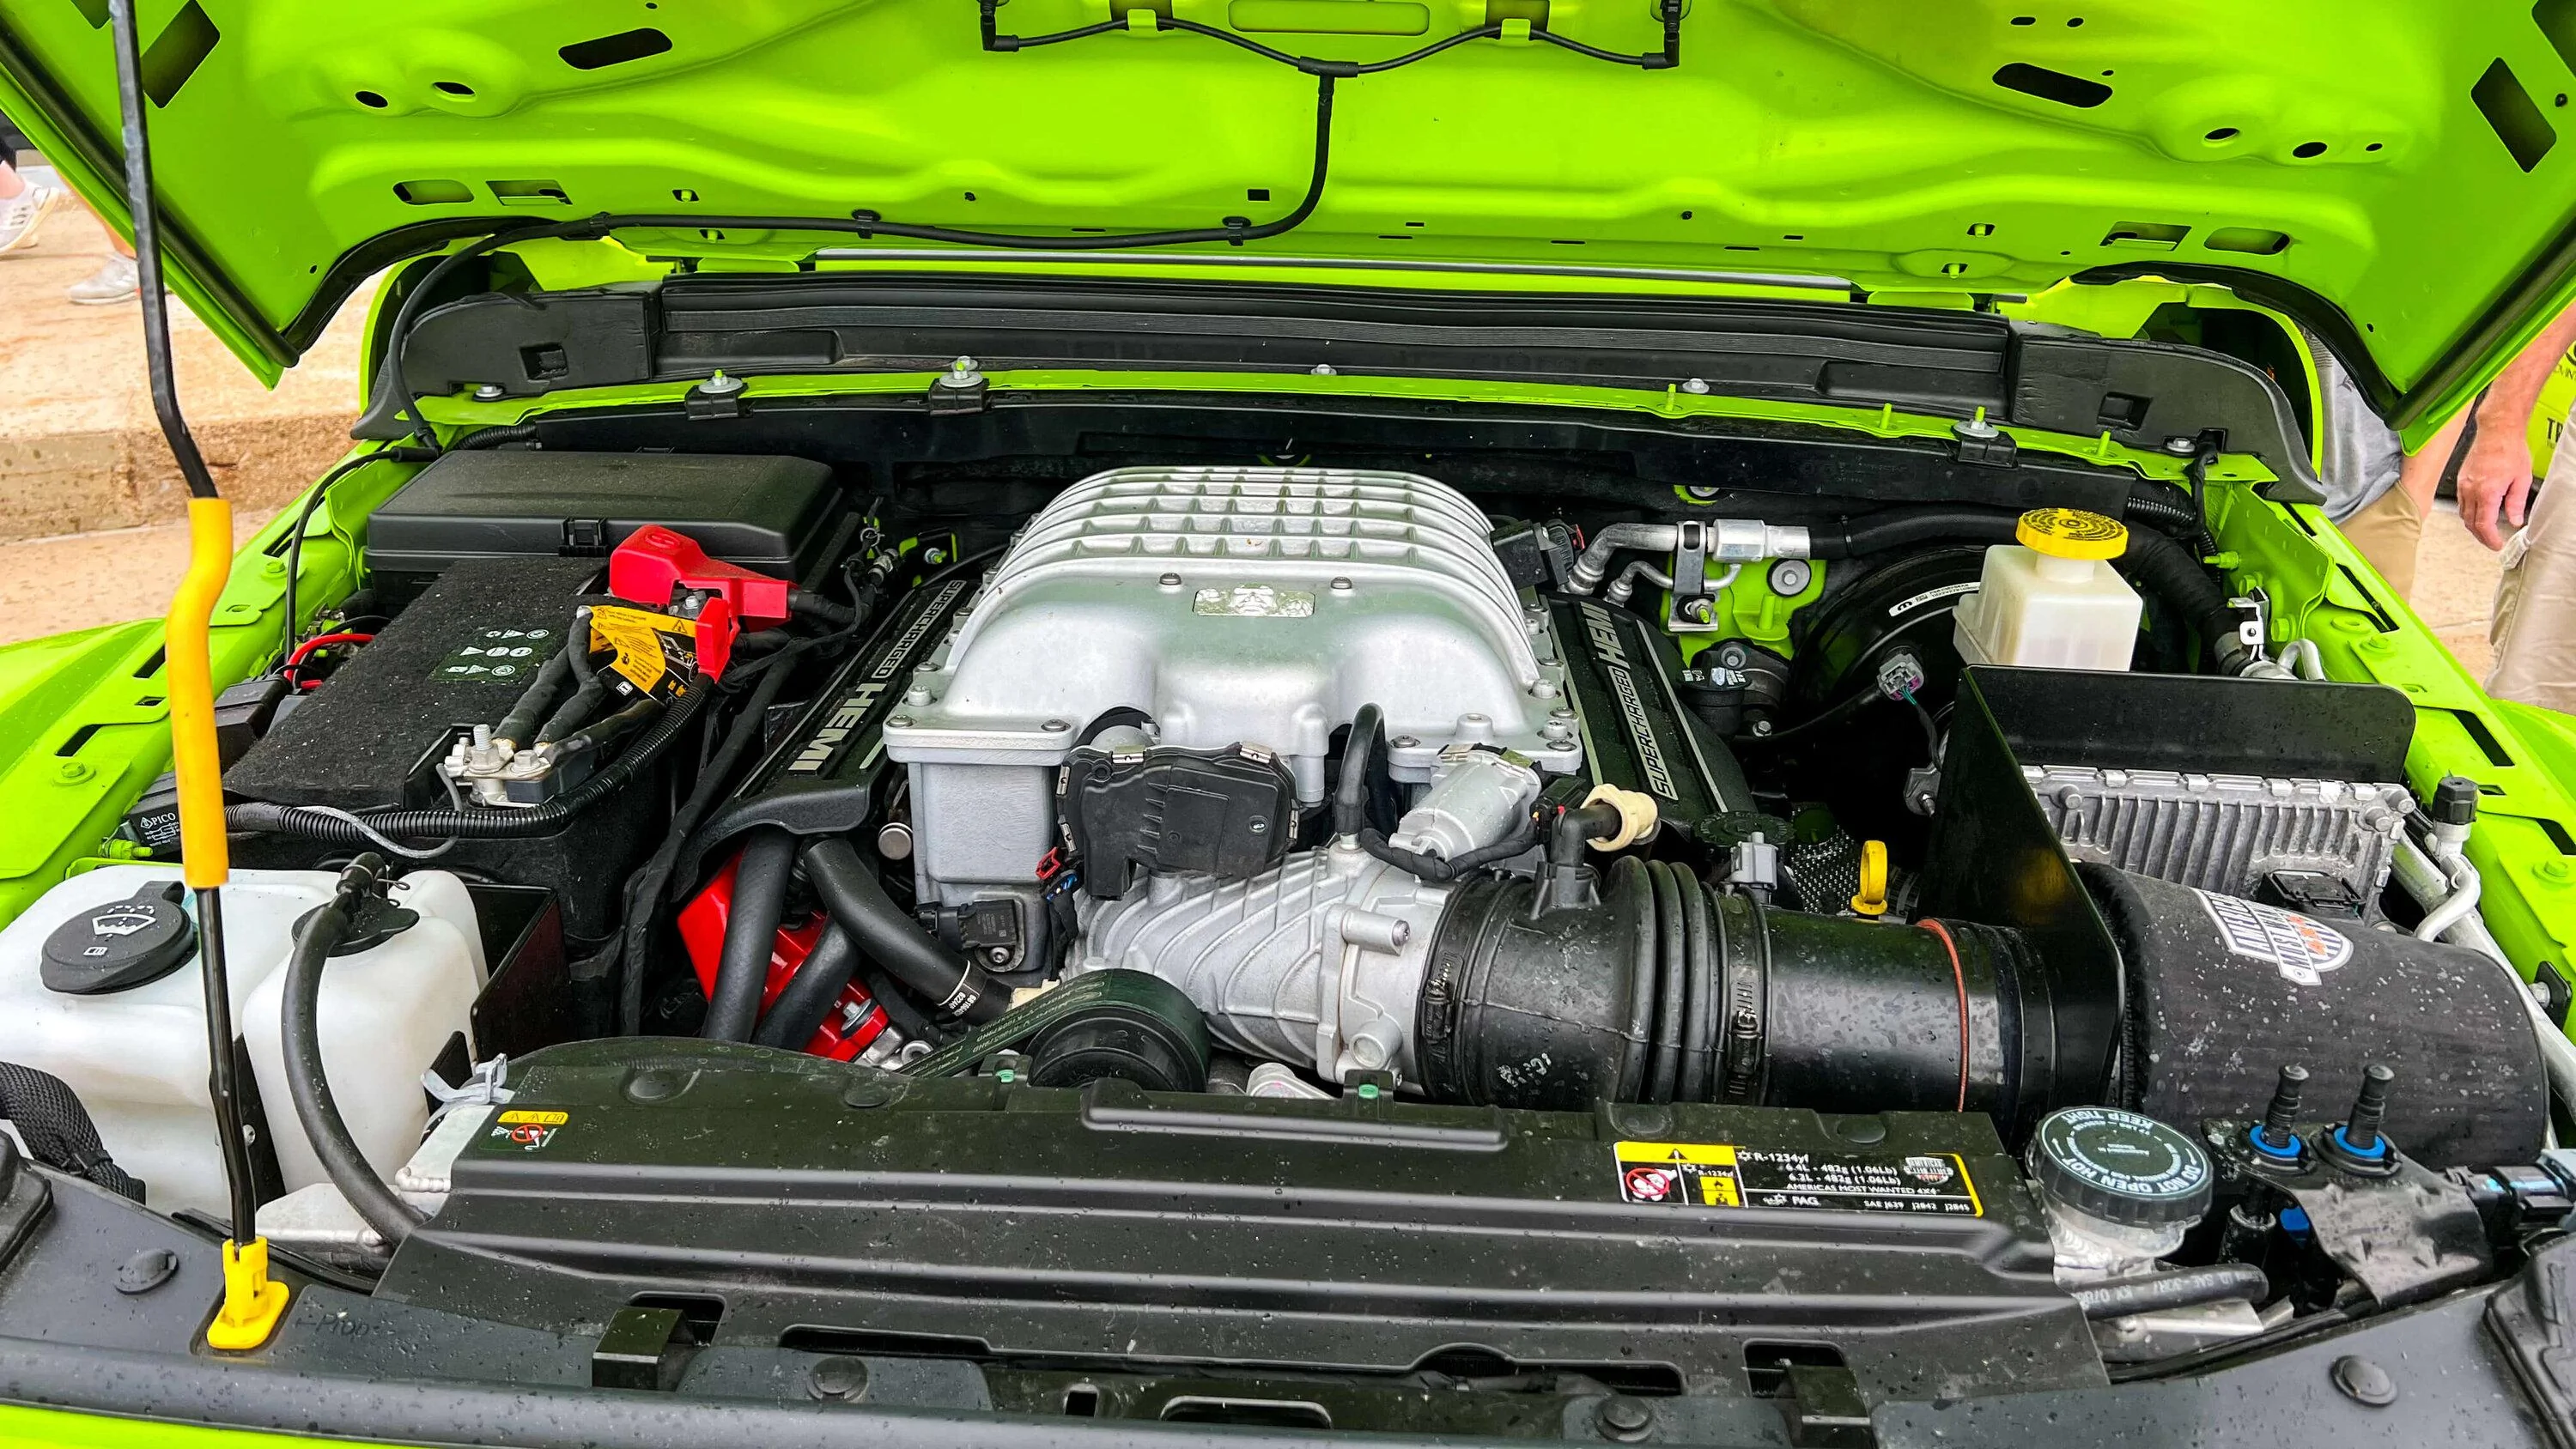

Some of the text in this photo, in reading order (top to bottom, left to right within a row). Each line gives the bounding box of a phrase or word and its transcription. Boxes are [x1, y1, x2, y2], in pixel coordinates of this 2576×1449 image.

[788, 581, 963, 771] SUPERCHARGED HEMI
[1581, 602, 1675, 799] SUPERCHARGED HEMI
[150, 812, 176, 825] PICO
[2062, 1110, 2104, 1125] TIGHT
[2107, 1112, 2154, 1131] KEEP
[1753, 1152, 1808, 1164] R-1234yf
[2062, 1156, 2202, 1193] DO NOT OPEN HOT
[1838, 1185, 1868, 1193] MOST
[1868, 1185, 1916, 1195] WANTED
[1863, 1200, 1882, 1209] SAE
